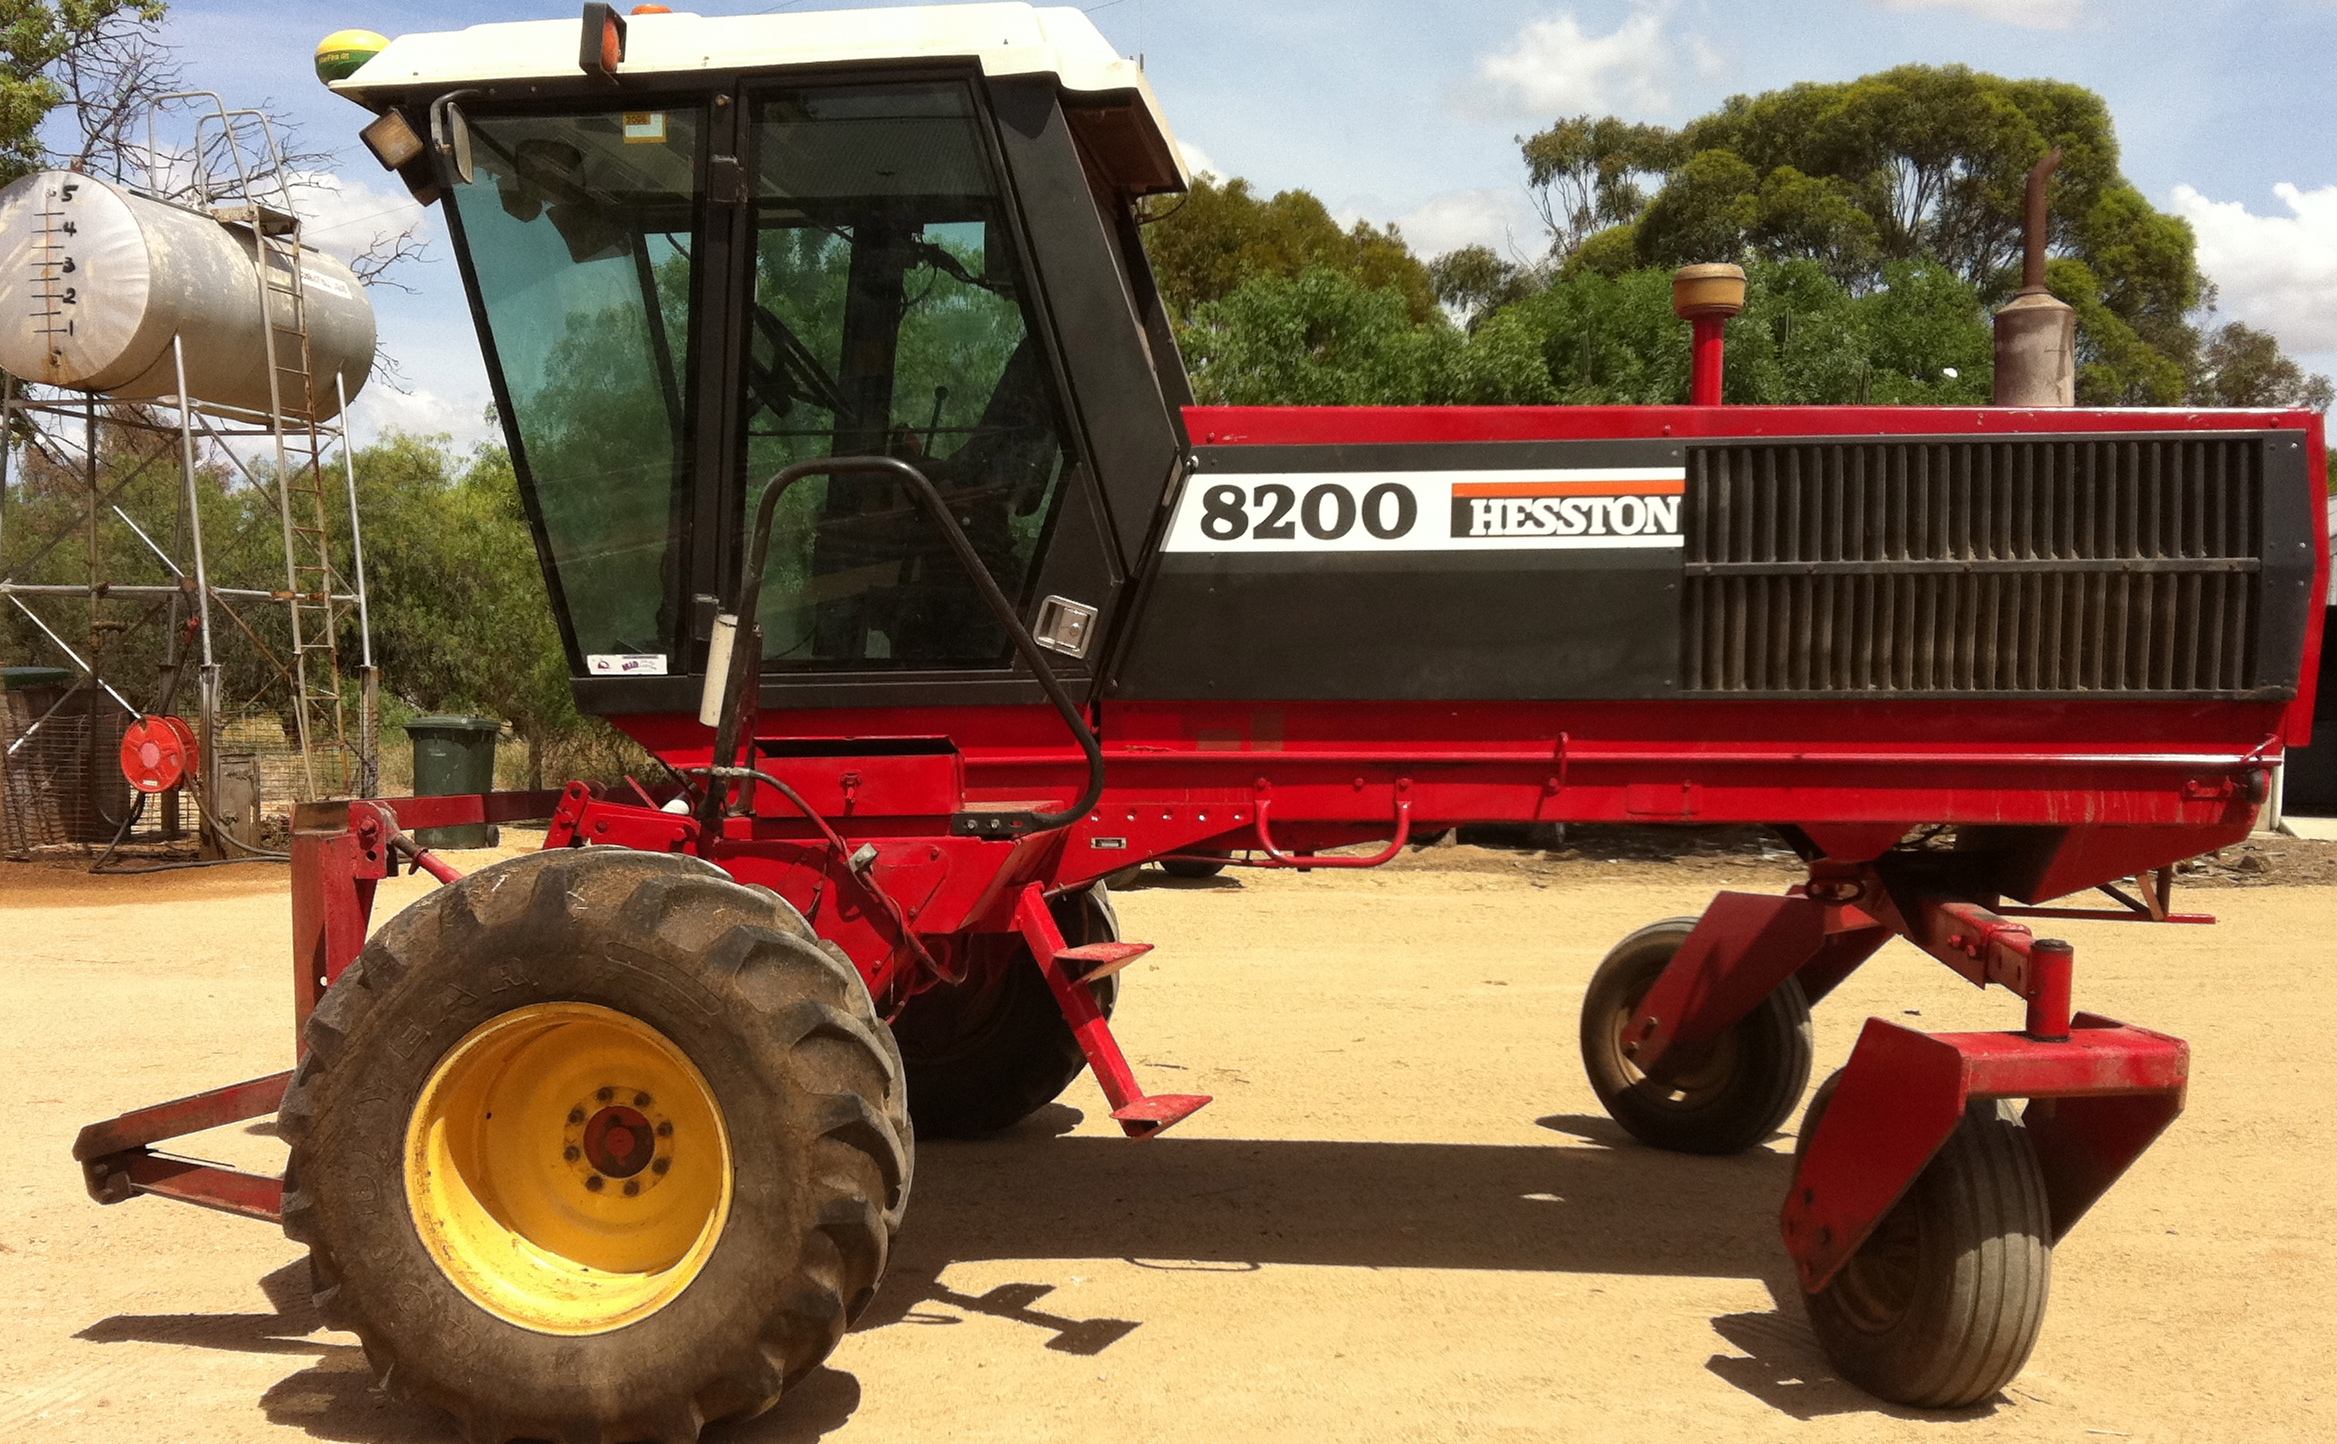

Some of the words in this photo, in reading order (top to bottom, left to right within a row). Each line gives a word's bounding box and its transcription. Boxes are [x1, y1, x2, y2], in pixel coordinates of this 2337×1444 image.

[61, 185, 79, 202] 5
[62, 221, 77, 237] 4
[62, 256, 76, 274] 3
[62, 287, 77, 304] 2
[68, 319, 74, 337] 1
[1200, 482, 1418, 541] 8200
[1469, 495, 1682, 536] HESSTON
